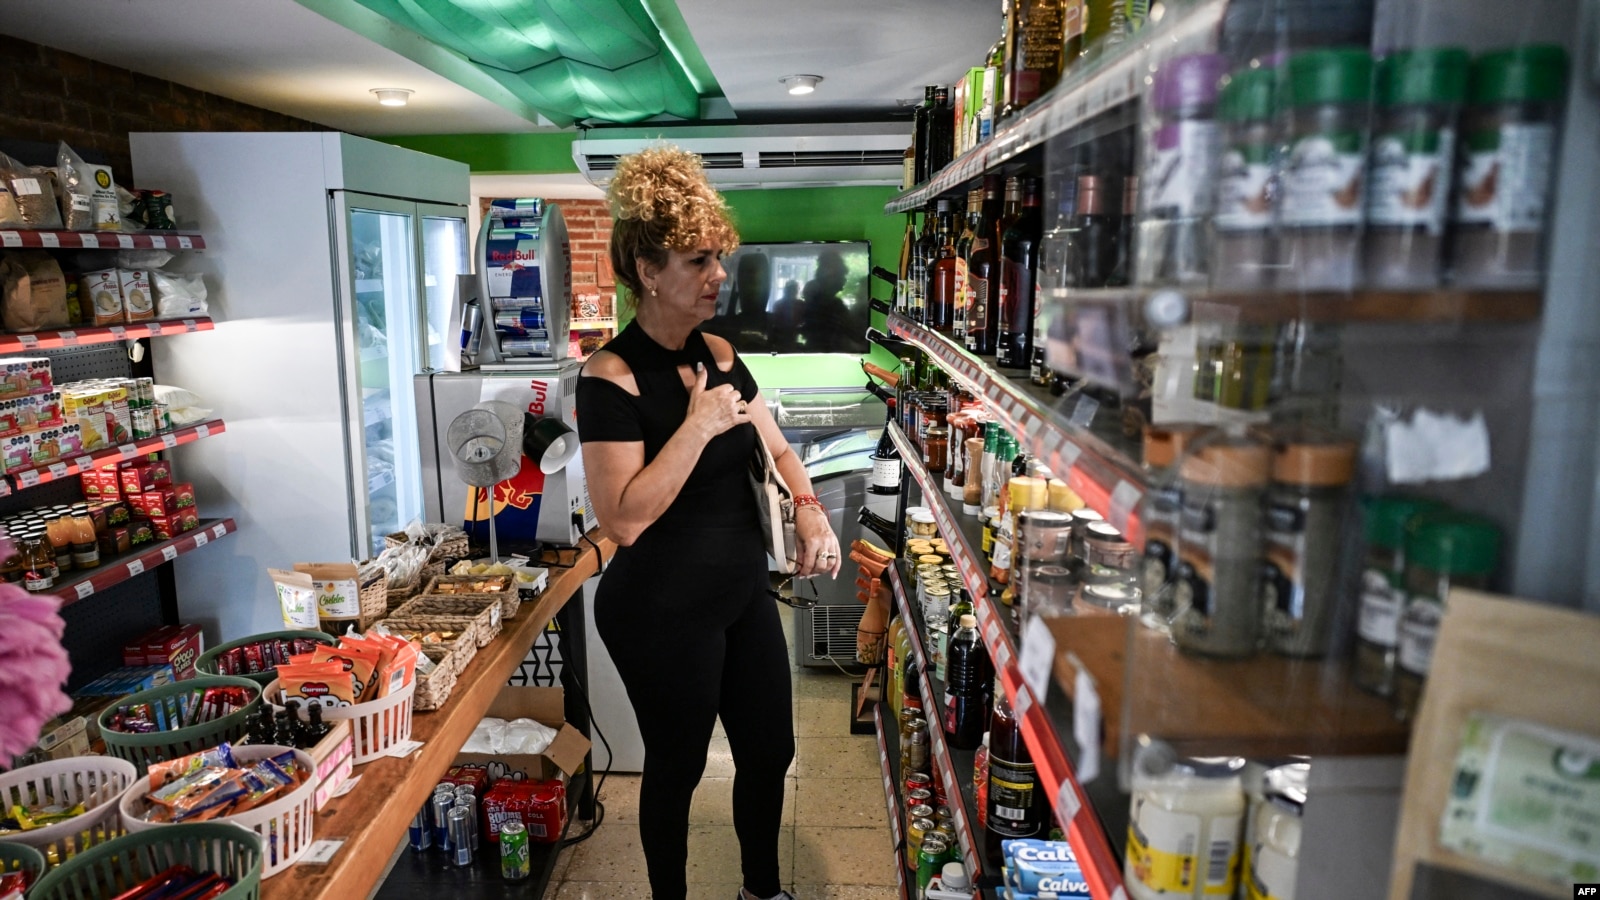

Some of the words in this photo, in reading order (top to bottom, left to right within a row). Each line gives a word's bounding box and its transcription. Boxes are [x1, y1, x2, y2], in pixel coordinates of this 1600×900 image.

[492, 249, 513, 261] Red
[514, 249, 535, 260] Bull
[528, 380, 548, 415] Bull
[171, 637, 188, 650] Gourmet
[173, 648, 194, 667] CHOCO
[1038, 877, 1090, 892] Calvo
